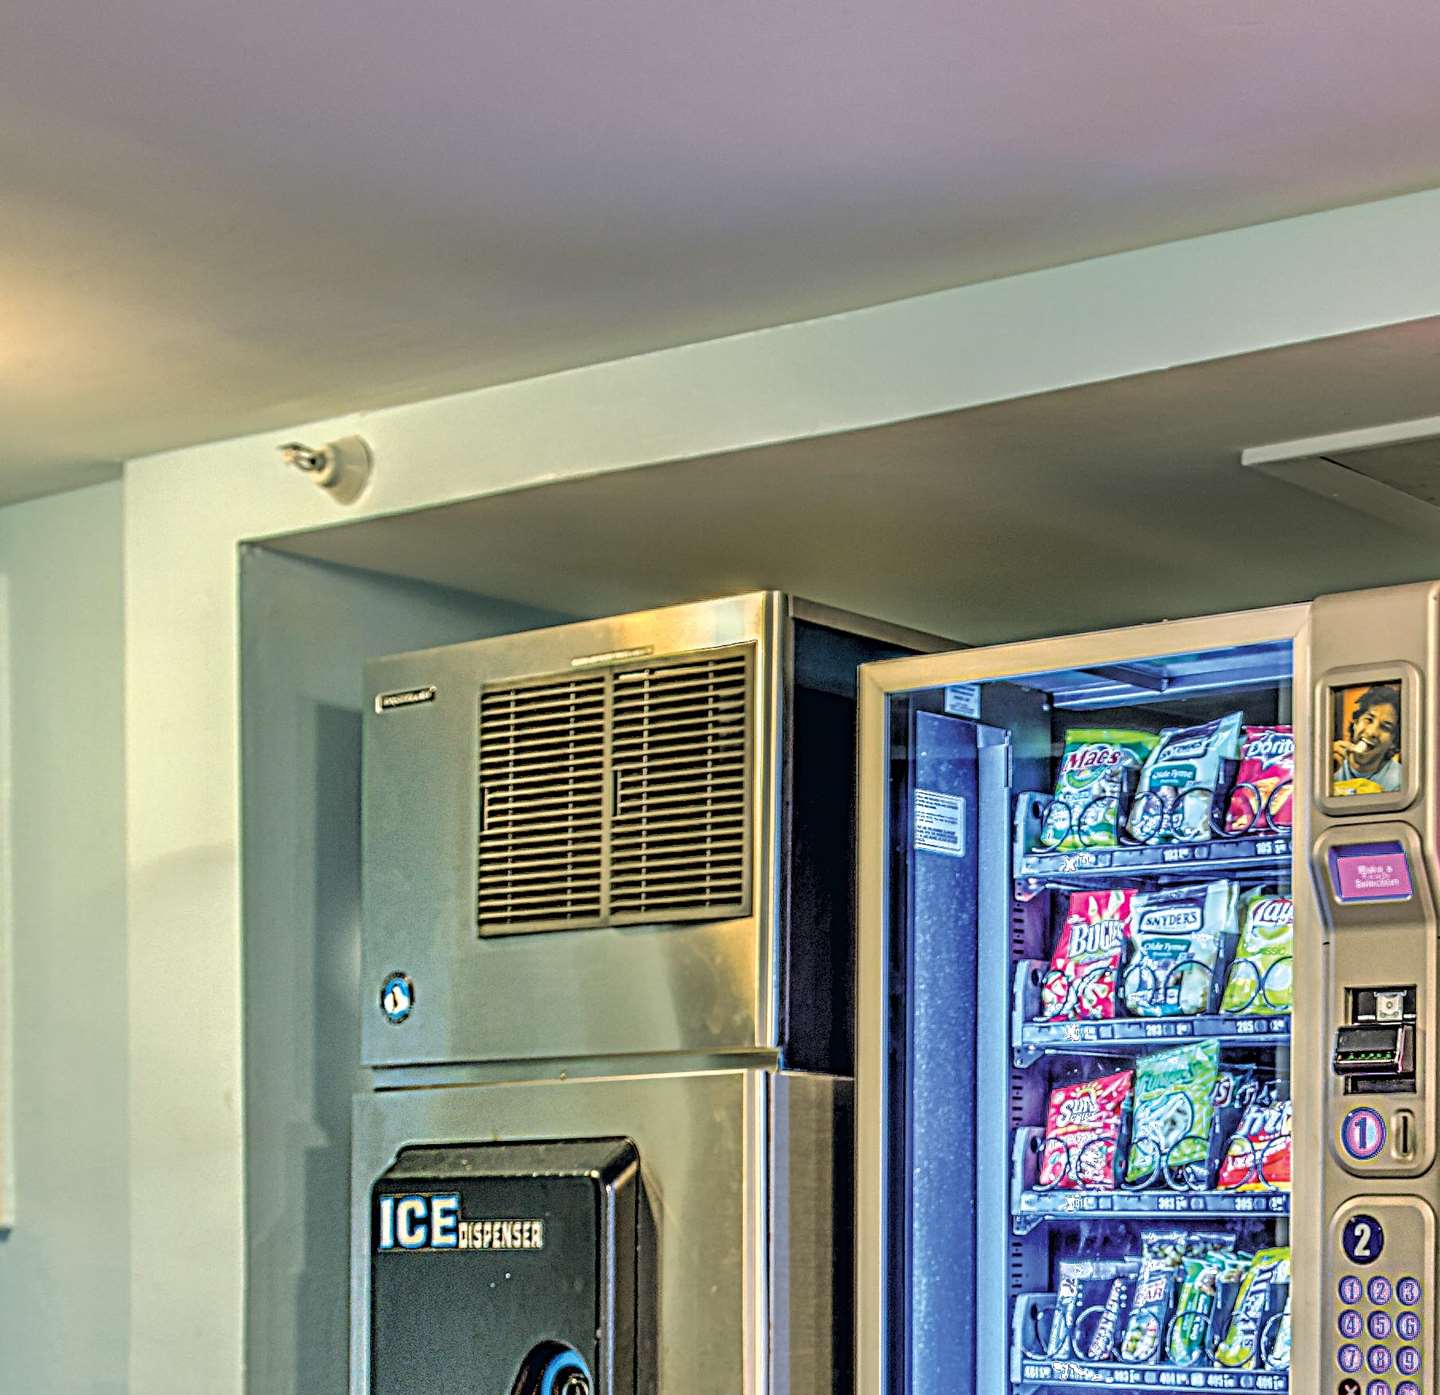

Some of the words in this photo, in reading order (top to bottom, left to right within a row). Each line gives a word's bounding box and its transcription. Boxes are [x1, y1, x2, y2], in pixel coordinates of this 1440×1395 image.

[1248, 739, 1294, 757] Dorit
[1354, 1117, 1367, 1149] 1
[380, 1193, 461, 1249] ICE
[459, 1220, 543, 1249] DISPENSER
[1354, 1222, 1371, 1257] 2
